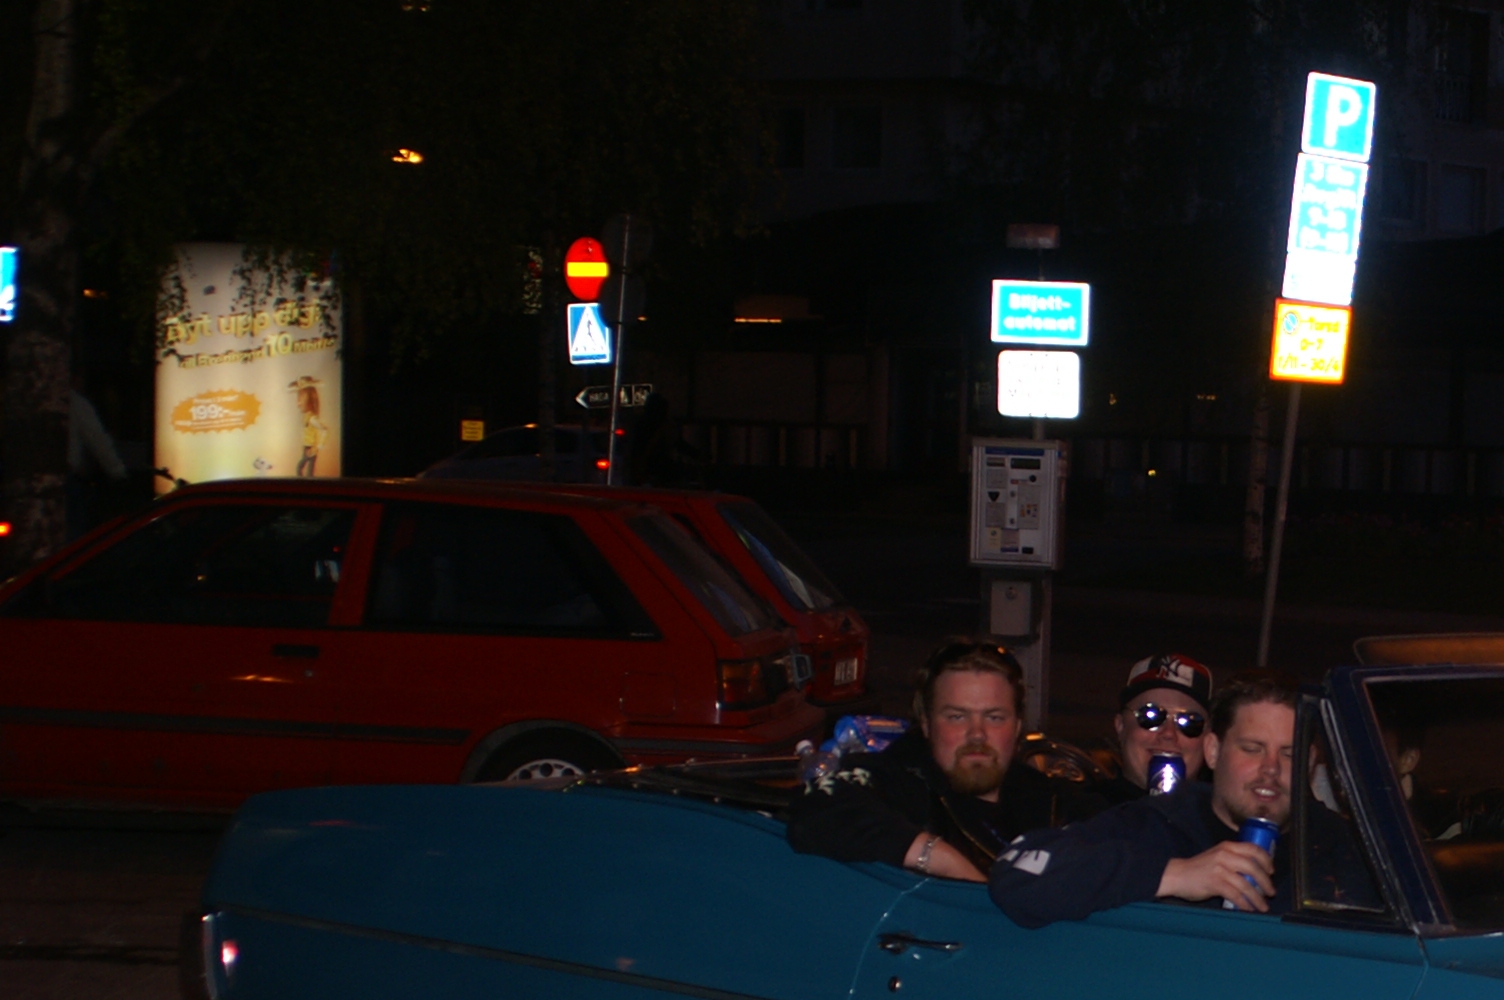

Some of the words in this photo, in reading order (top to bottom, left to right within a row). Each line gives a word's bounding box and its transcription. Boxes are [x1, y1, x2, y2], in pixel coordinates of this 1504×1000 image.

[1324, 84, 1362, 147] P
[217, 309, 271, 338] upp
[265, 331, 293, 358] 10
